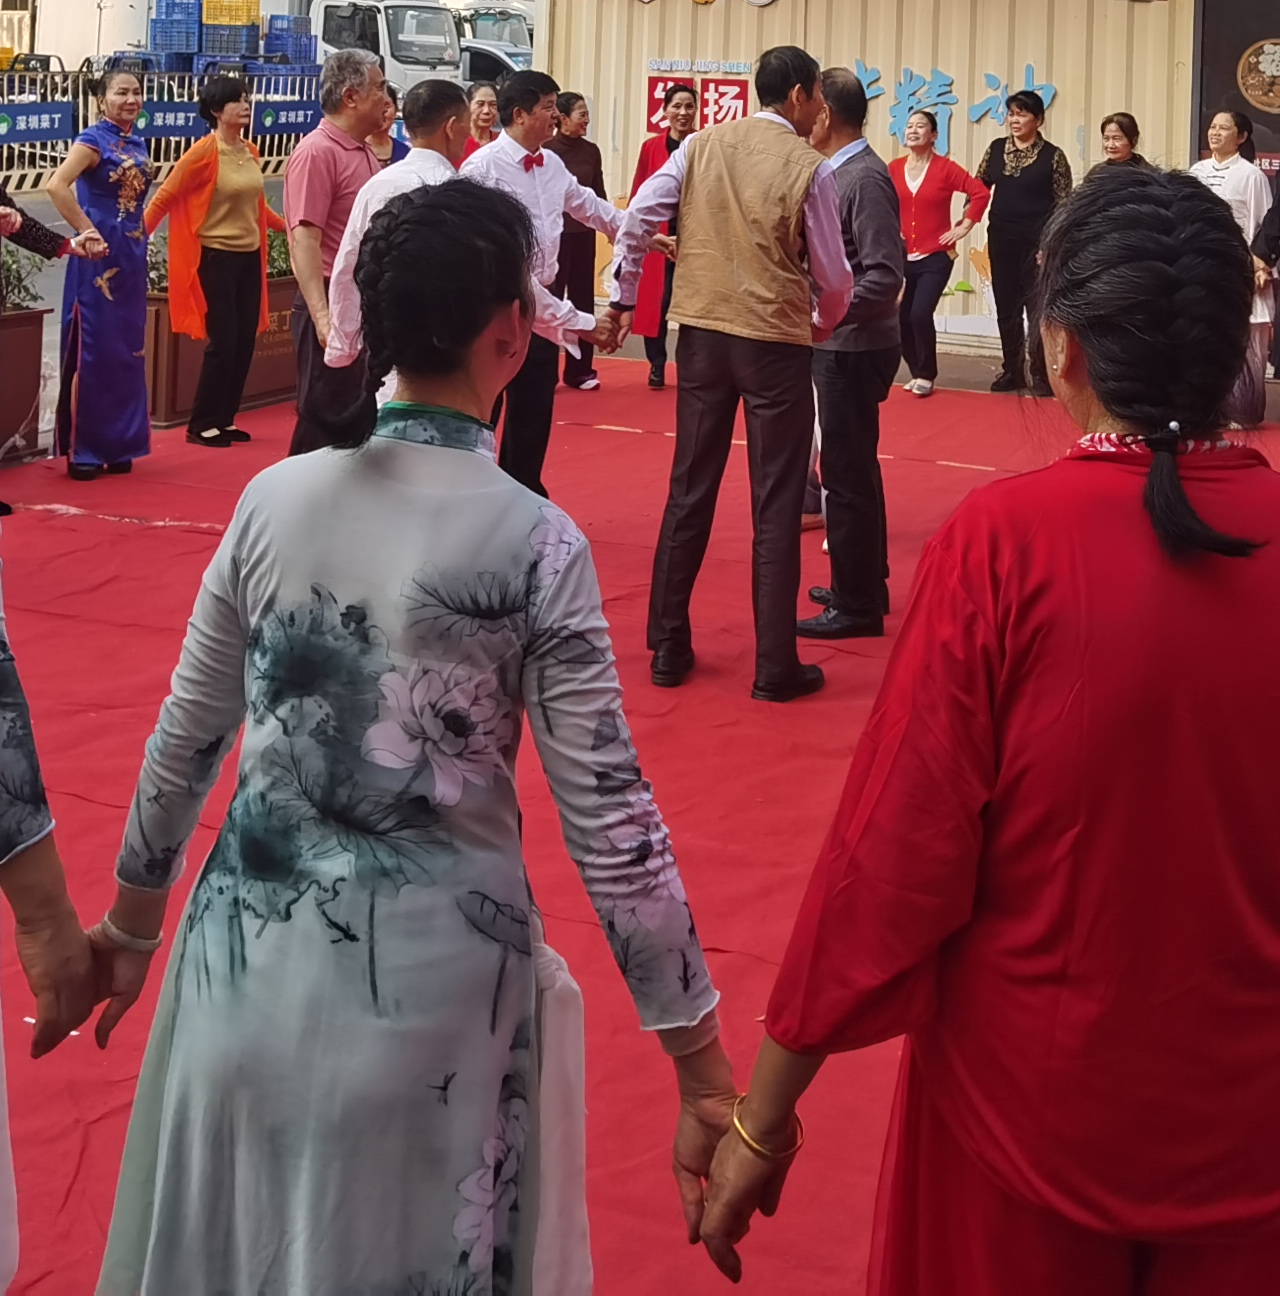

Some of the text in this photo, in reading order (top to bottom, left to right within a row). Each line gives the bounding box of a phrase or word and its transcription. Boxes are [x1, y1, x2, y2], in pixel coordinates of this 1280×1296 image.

[648, 57, 751, 74] SAN NIU JING SHEN
[15, 114, 62, 130] 深圳菜丁
[153, 112, 197, 127] 深圳菜丁
[278, 110, 314, 124] 深圳菜丁
